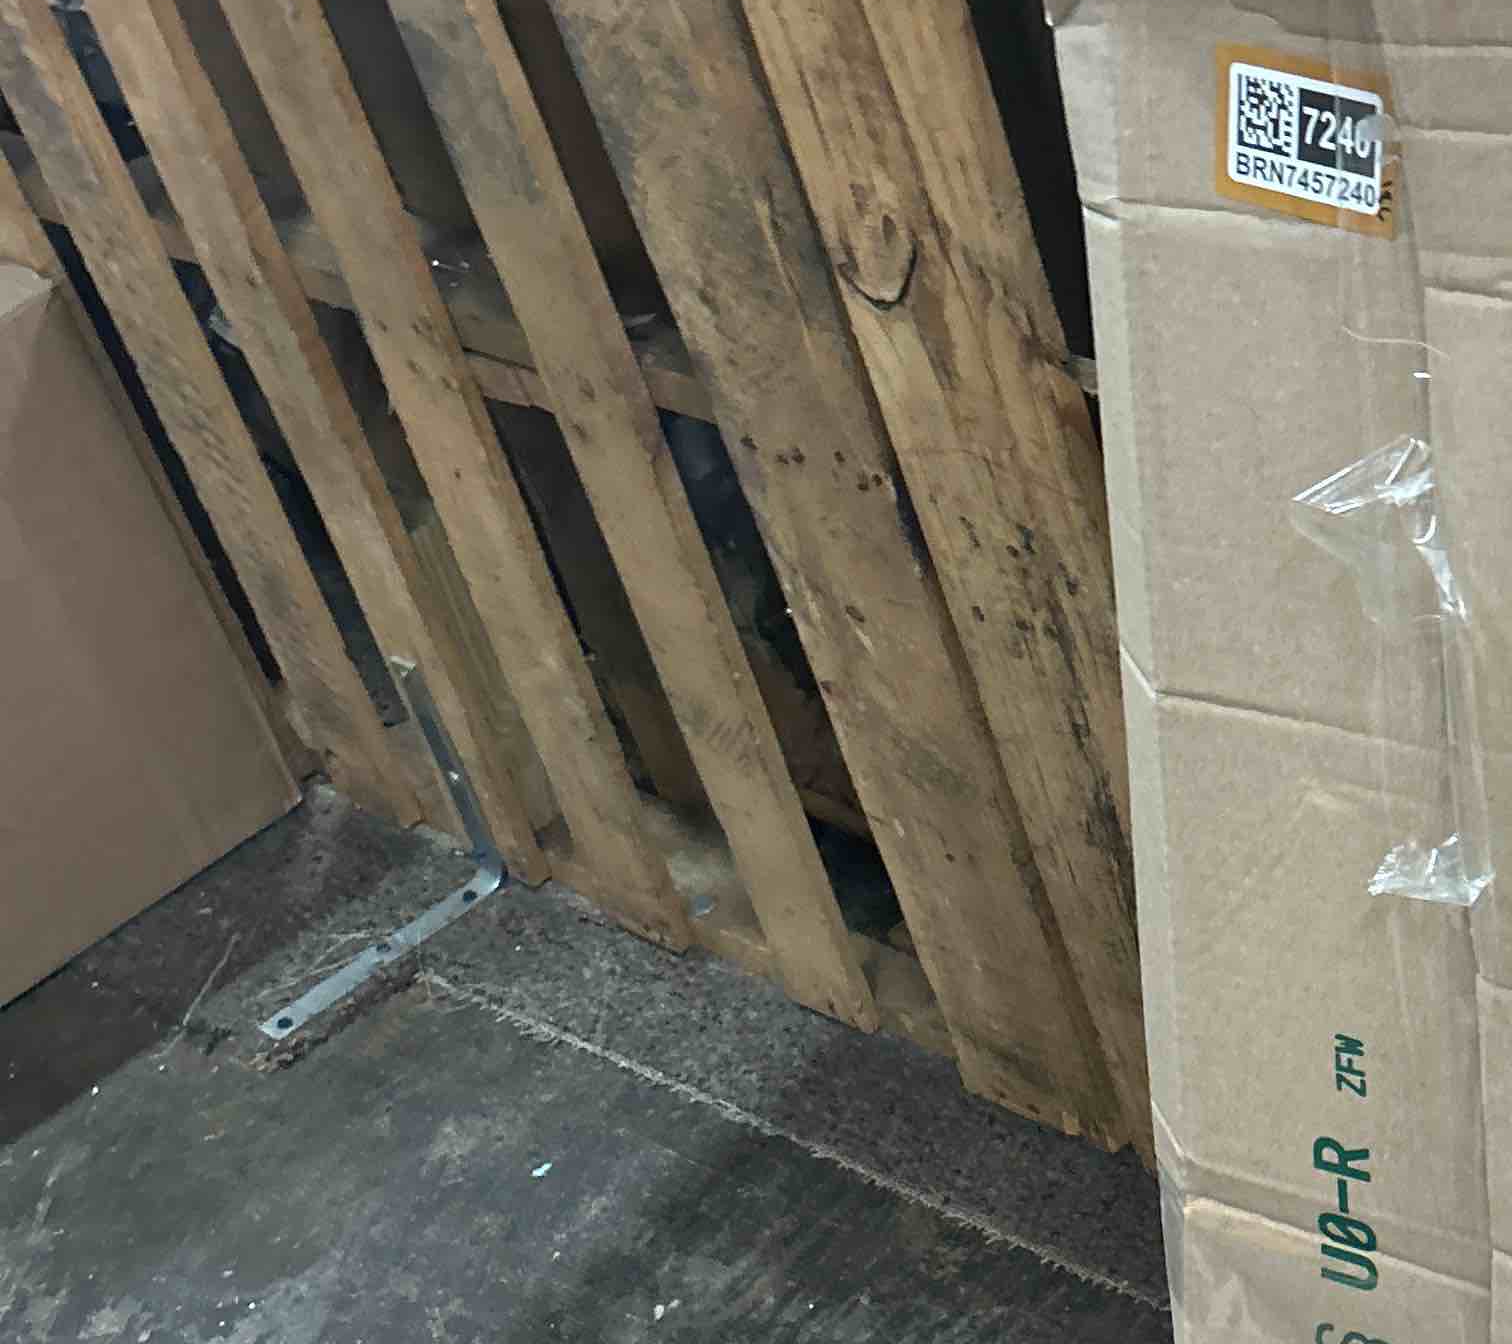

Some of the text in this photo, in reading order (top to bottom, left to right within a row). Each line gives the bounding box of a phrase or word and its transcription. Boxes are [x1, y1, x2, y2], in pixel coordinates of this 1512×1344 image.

[1302, 105, 1374, 159] 7240
[1235, 152, 1377, 208] BRN7457240
[1334, 1032, 1368, 1097] ZFW
